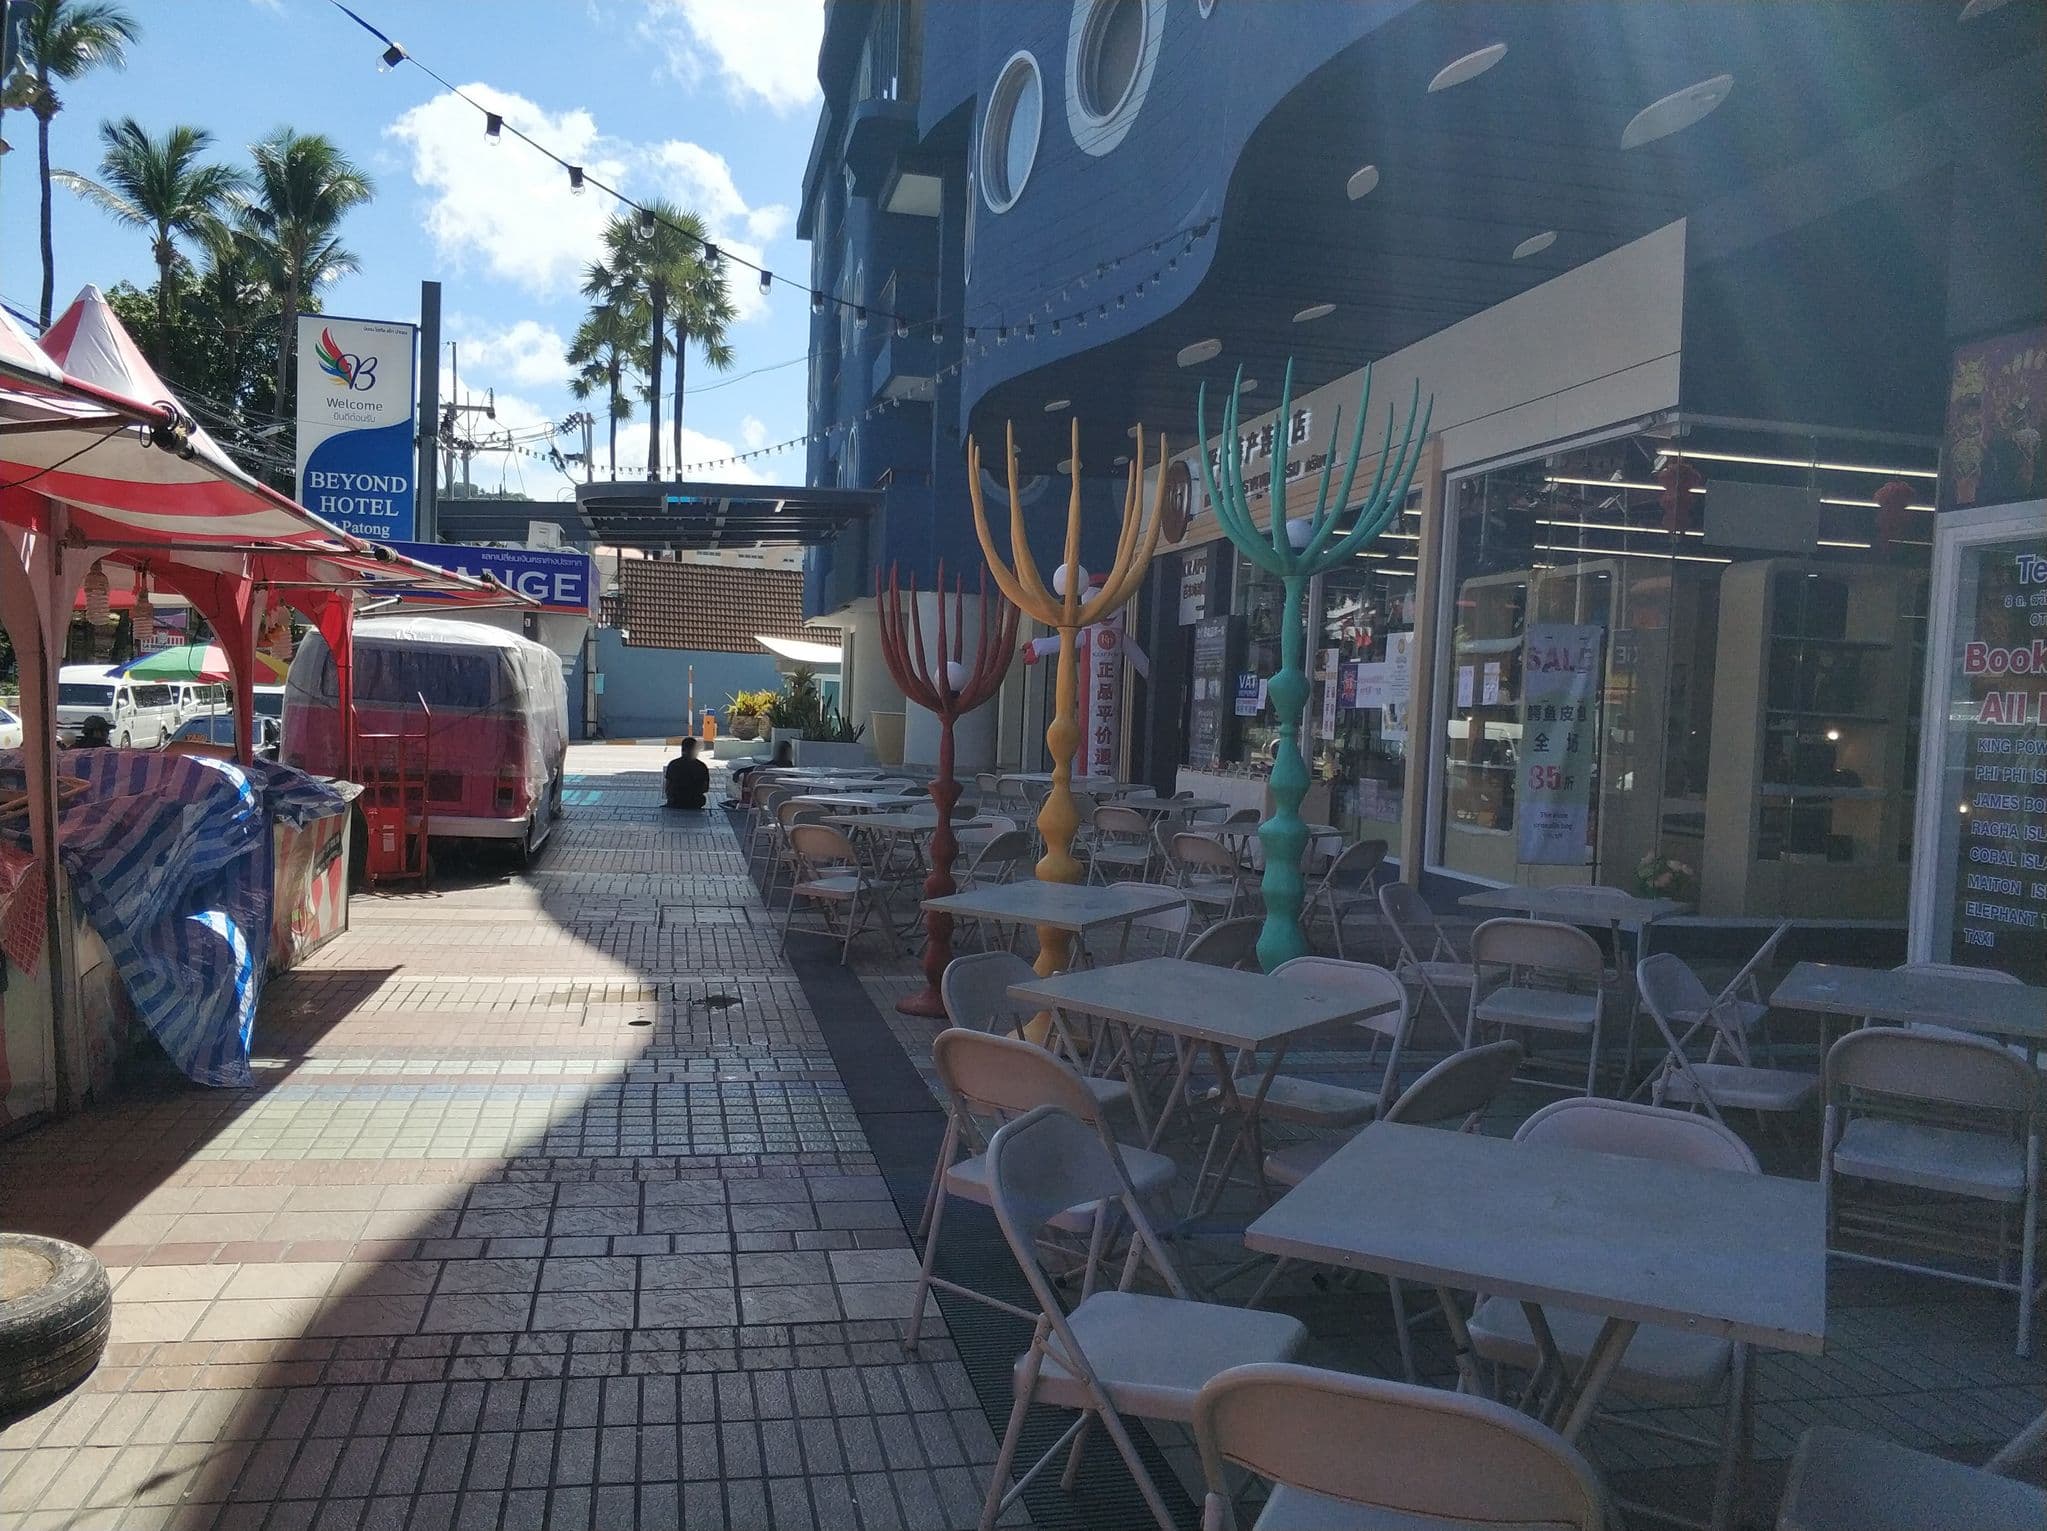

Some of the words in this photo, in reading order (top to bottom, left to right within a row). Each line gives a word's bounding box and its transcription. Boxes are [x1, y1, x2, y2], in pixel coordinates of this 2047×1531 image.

[326, 397, 383, 412] Welcome
[309, 471, 408, 494] BEYOND
[320, 495, 400, 517] HOTEL
[341, 519, 391, 539] Patong
[1526, 646, 1594, 674] SALE
[1977, 691, 2028, 726] All
[1977, 738, 2011, 753] KING
[1975, 764, 1999, 781] PHI
[2003, 767, 2027, 784] PHI
[1973, 792, 2019, 811] JAMES
[2024, 797, 2047, 814] BO
[1971, 820, 2019, 840] RACHA
[1969, 847, 2017, 867] CORAL
[1968, 874, 2022, 896] MAITON
[2031, 883, 2047, 900] IS
[1965, 901, 2038, 927] ELEPHANT
[1964, 928, 1994, 948] TAXI
